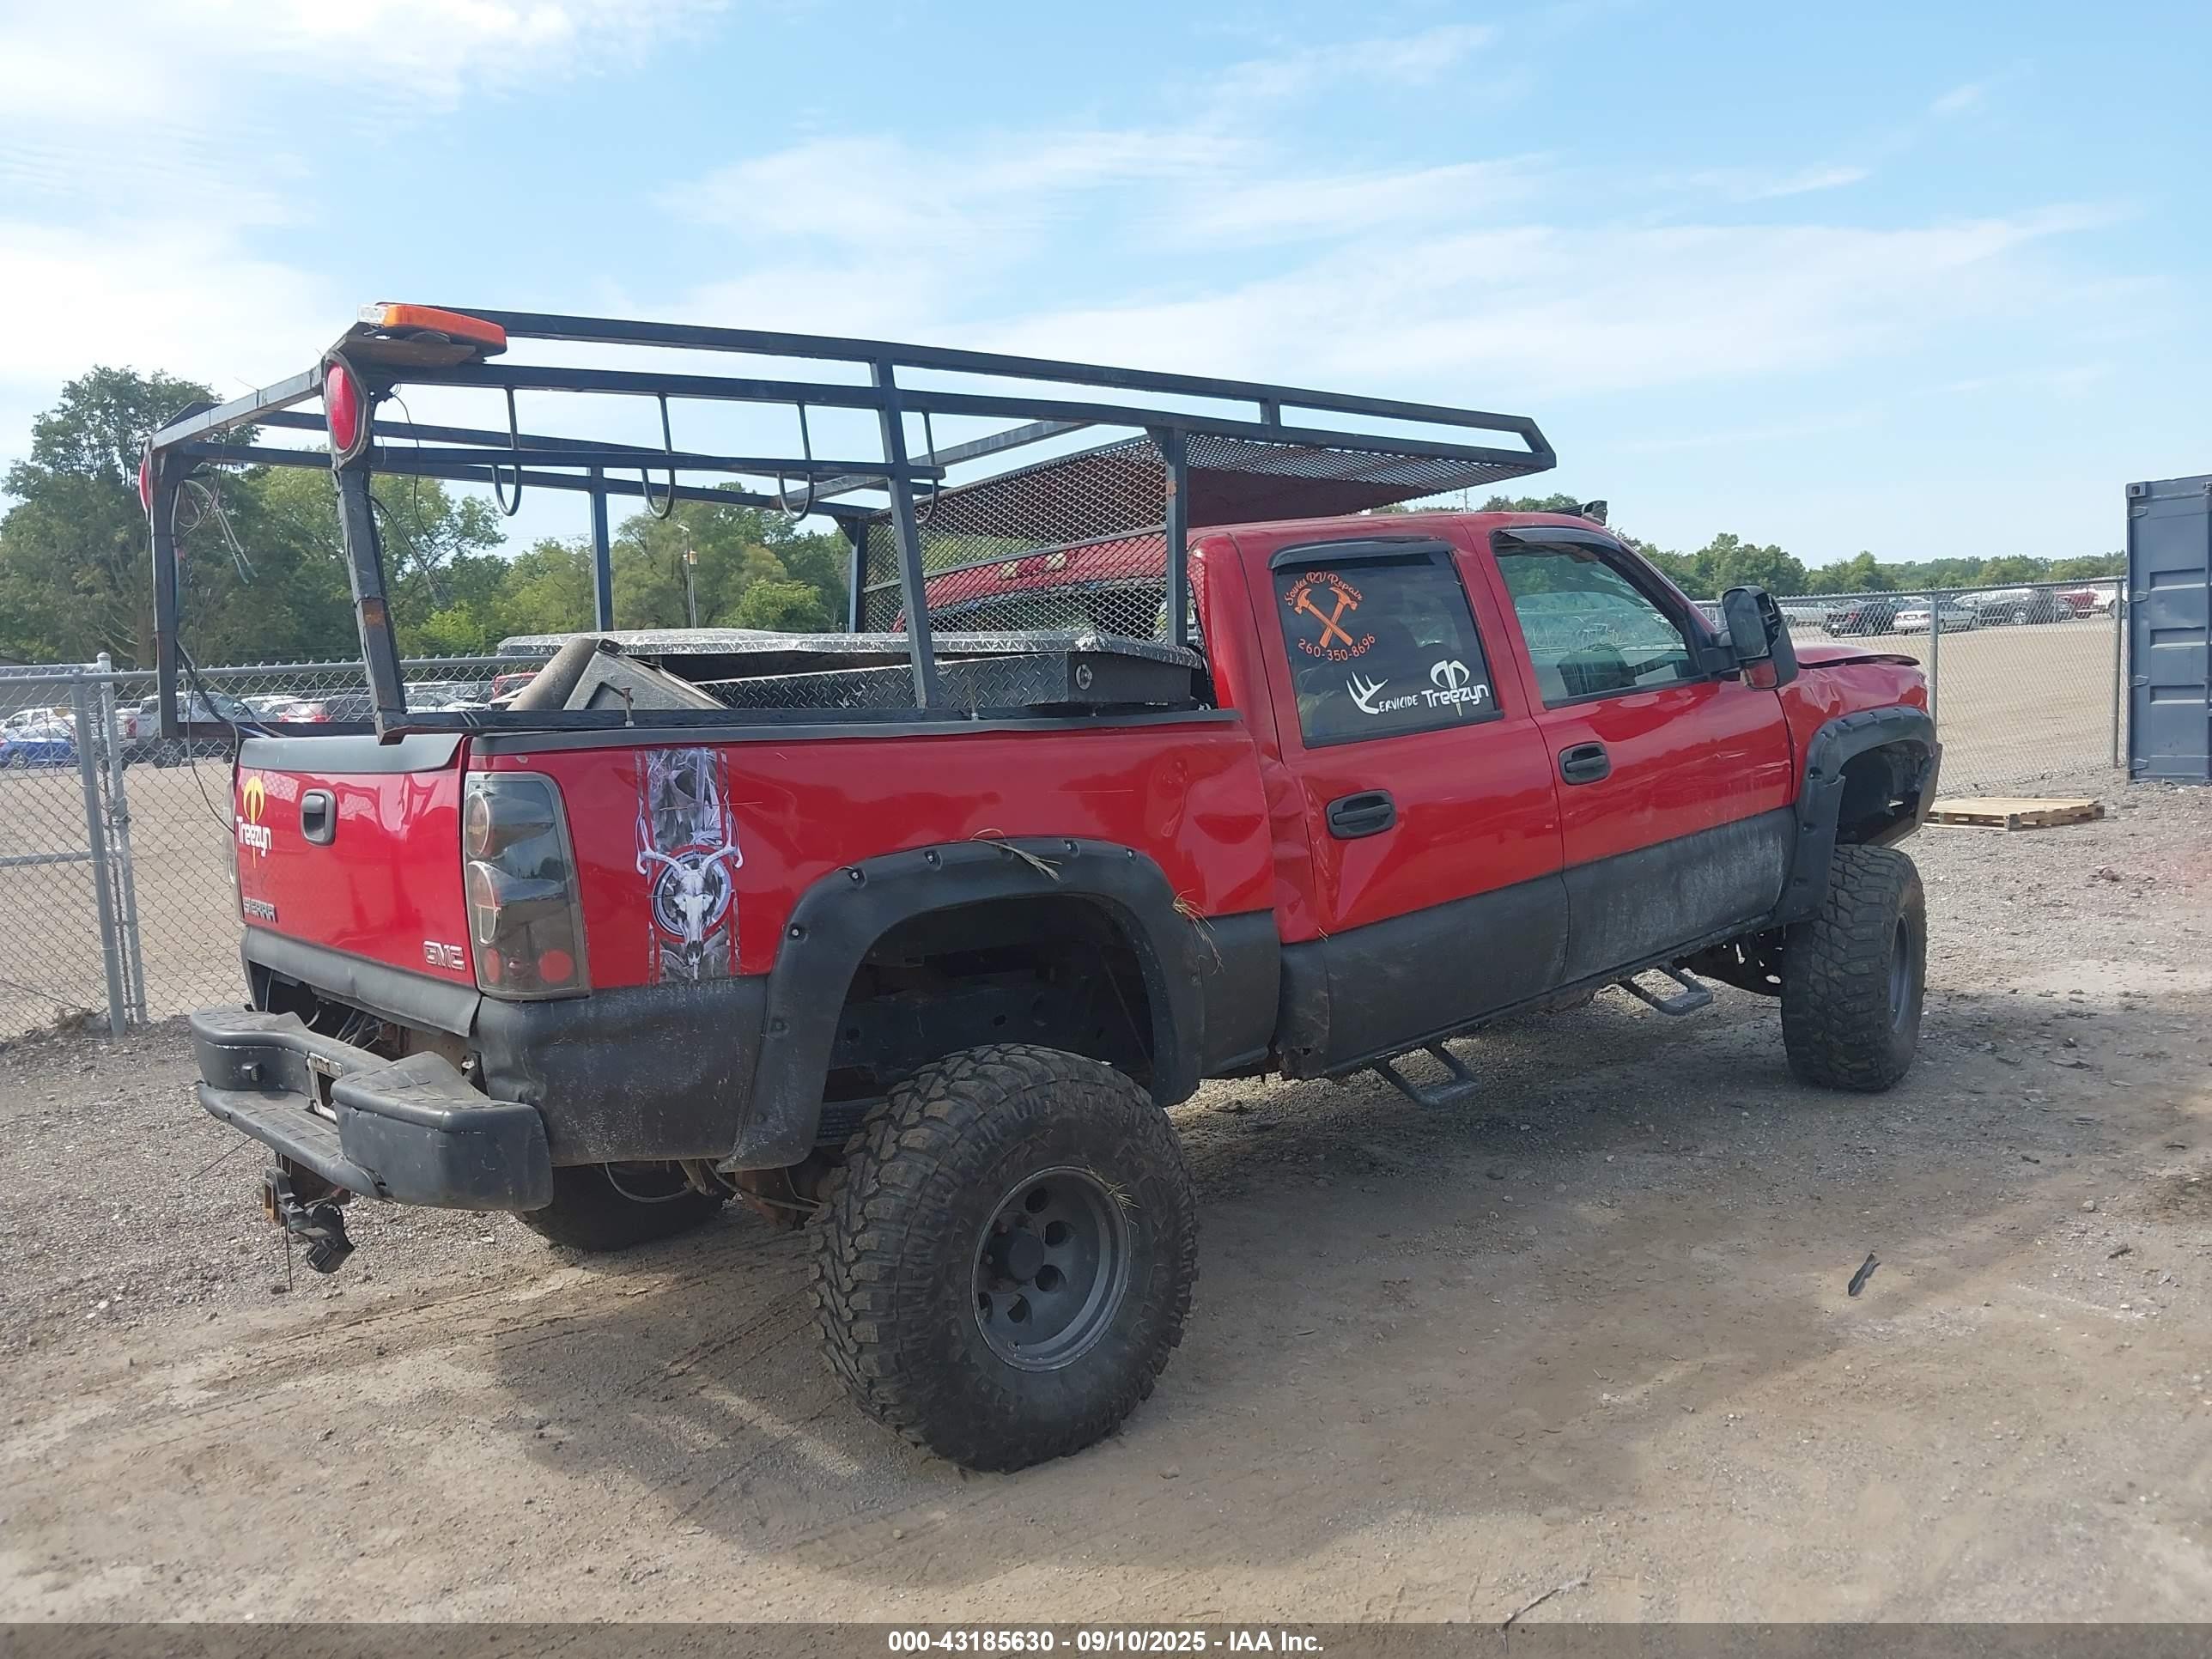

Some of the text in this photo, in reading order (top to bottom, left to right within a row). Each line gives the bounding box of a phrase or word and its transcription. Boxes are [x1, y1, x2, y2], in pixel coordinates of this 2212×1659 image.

[1306, 571, 1327, 584] RV
[1327, 573, 1363, 601] Repair
[1297, 633, 1376, 661] 260-350-8696
[1420, 684, 1490, 708] Treezyn
[236, 816, 272, 858] Treezyn
[243, 896, 276, 923] SIERRA
[422, 940, 466, 970] GMC
